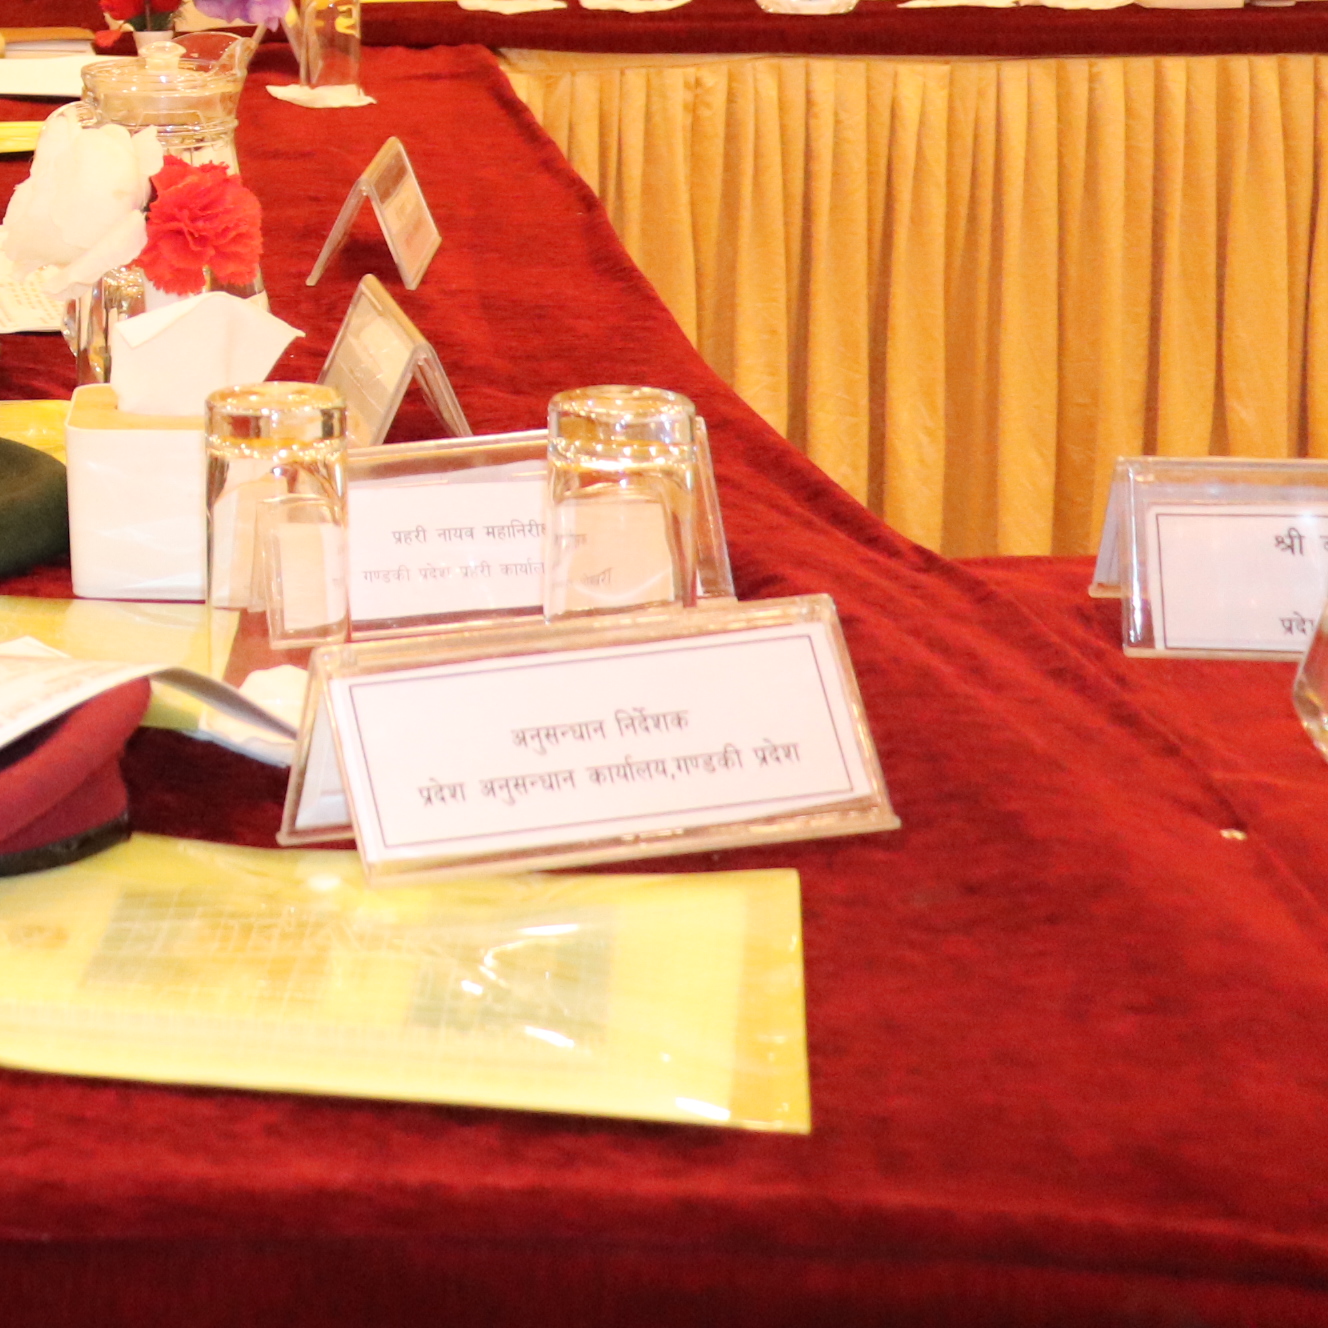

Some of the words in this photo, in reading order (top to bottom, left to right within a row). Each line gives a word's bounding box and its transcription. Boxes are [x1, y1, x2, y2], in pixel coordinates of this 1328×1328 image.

[392, 524, 428, 545] प्रहरी
[1274, 527, 1305, 556] श्री
[362, 563, 410, 585] गण्डकी
[418, 562, 452, 580] प्रदेश
[500, 556, 545, 577] कार्याल
[510, 719, 608, 756] अनुसन्धान
[614, 707, 690, 738] निर्देशक
[417, 776, 467, 806] प्रदेश
[479, 769, 576, 806] अनुसन्धान
[751, 738, 801, 767] प्रदेश
